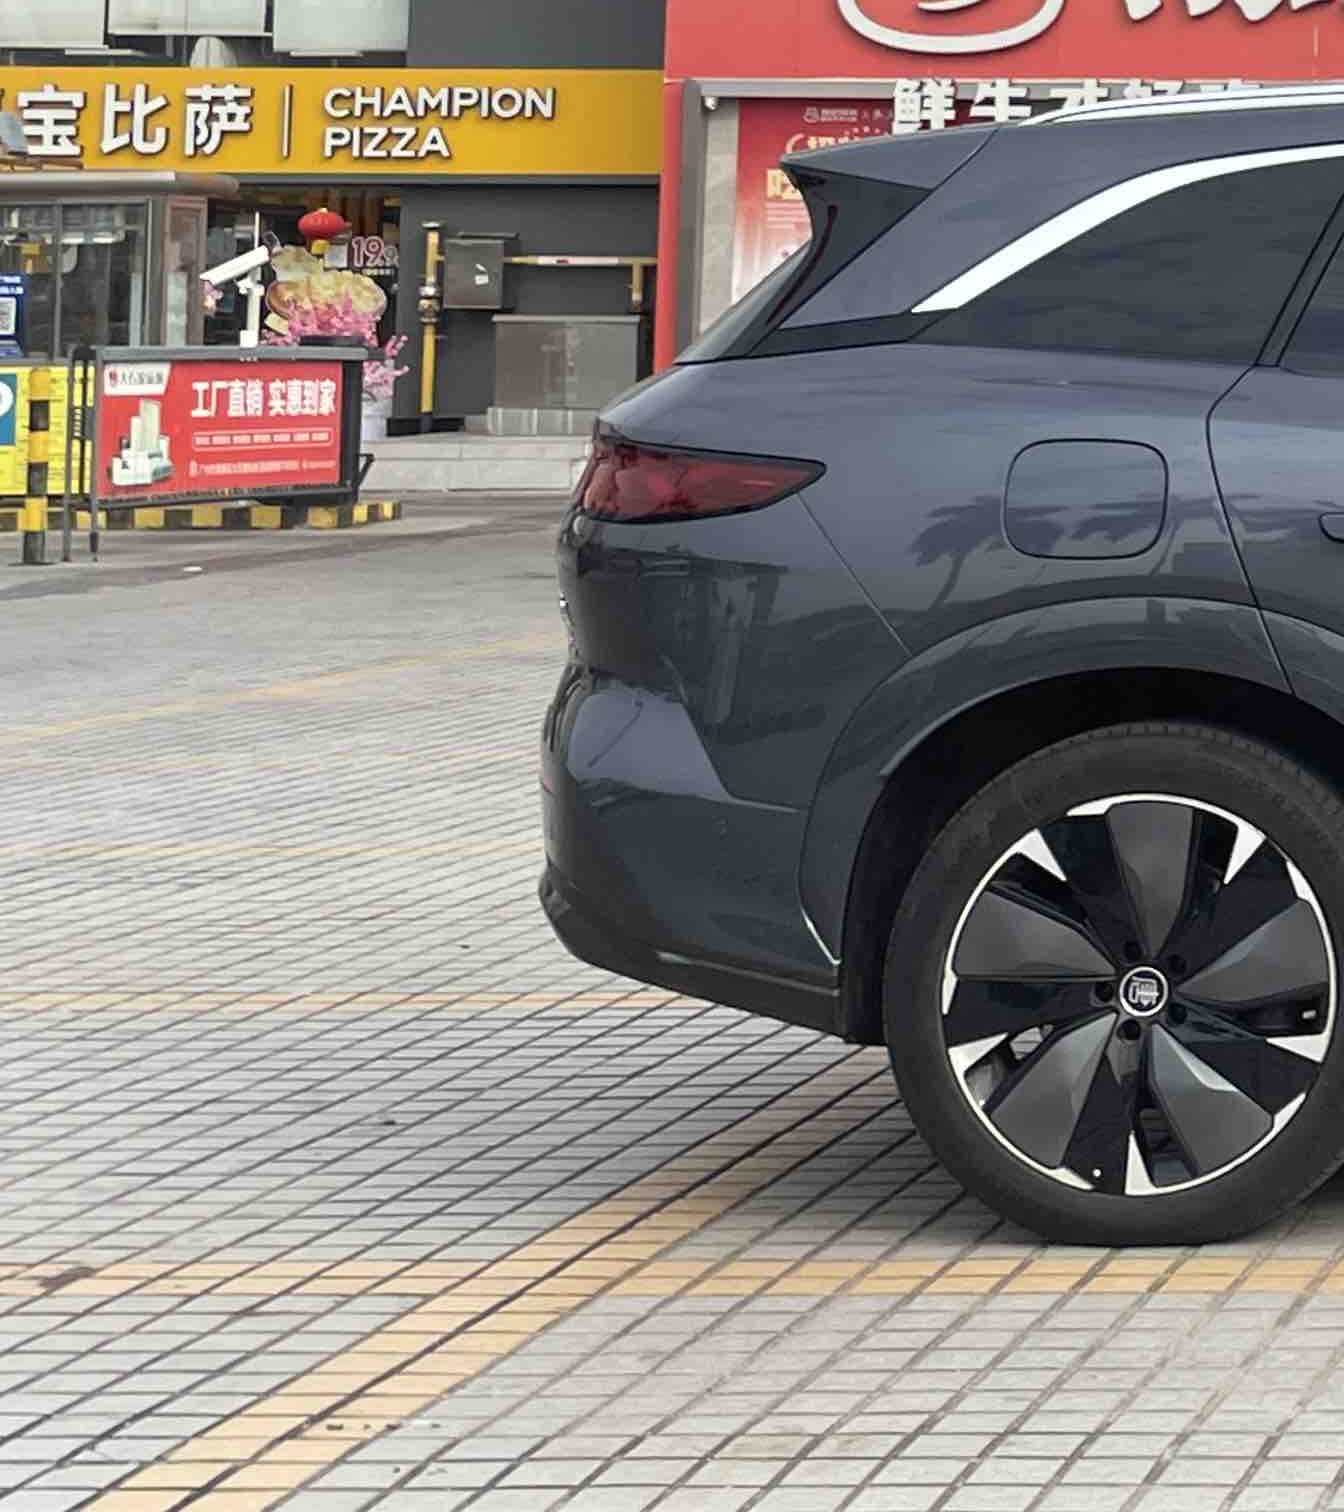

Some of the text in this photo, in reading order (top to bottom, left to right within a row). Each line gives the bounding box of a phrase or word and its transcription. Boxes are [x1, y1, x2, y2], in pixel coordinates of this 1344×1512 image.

[13, 83, 253, 158] 宝比萨
[322, 87, 555, 120] CHAMPION
[322, 125, 451, 159] PIZZA
[190, 377, 337, 418] 工厂直销 实惠到家
